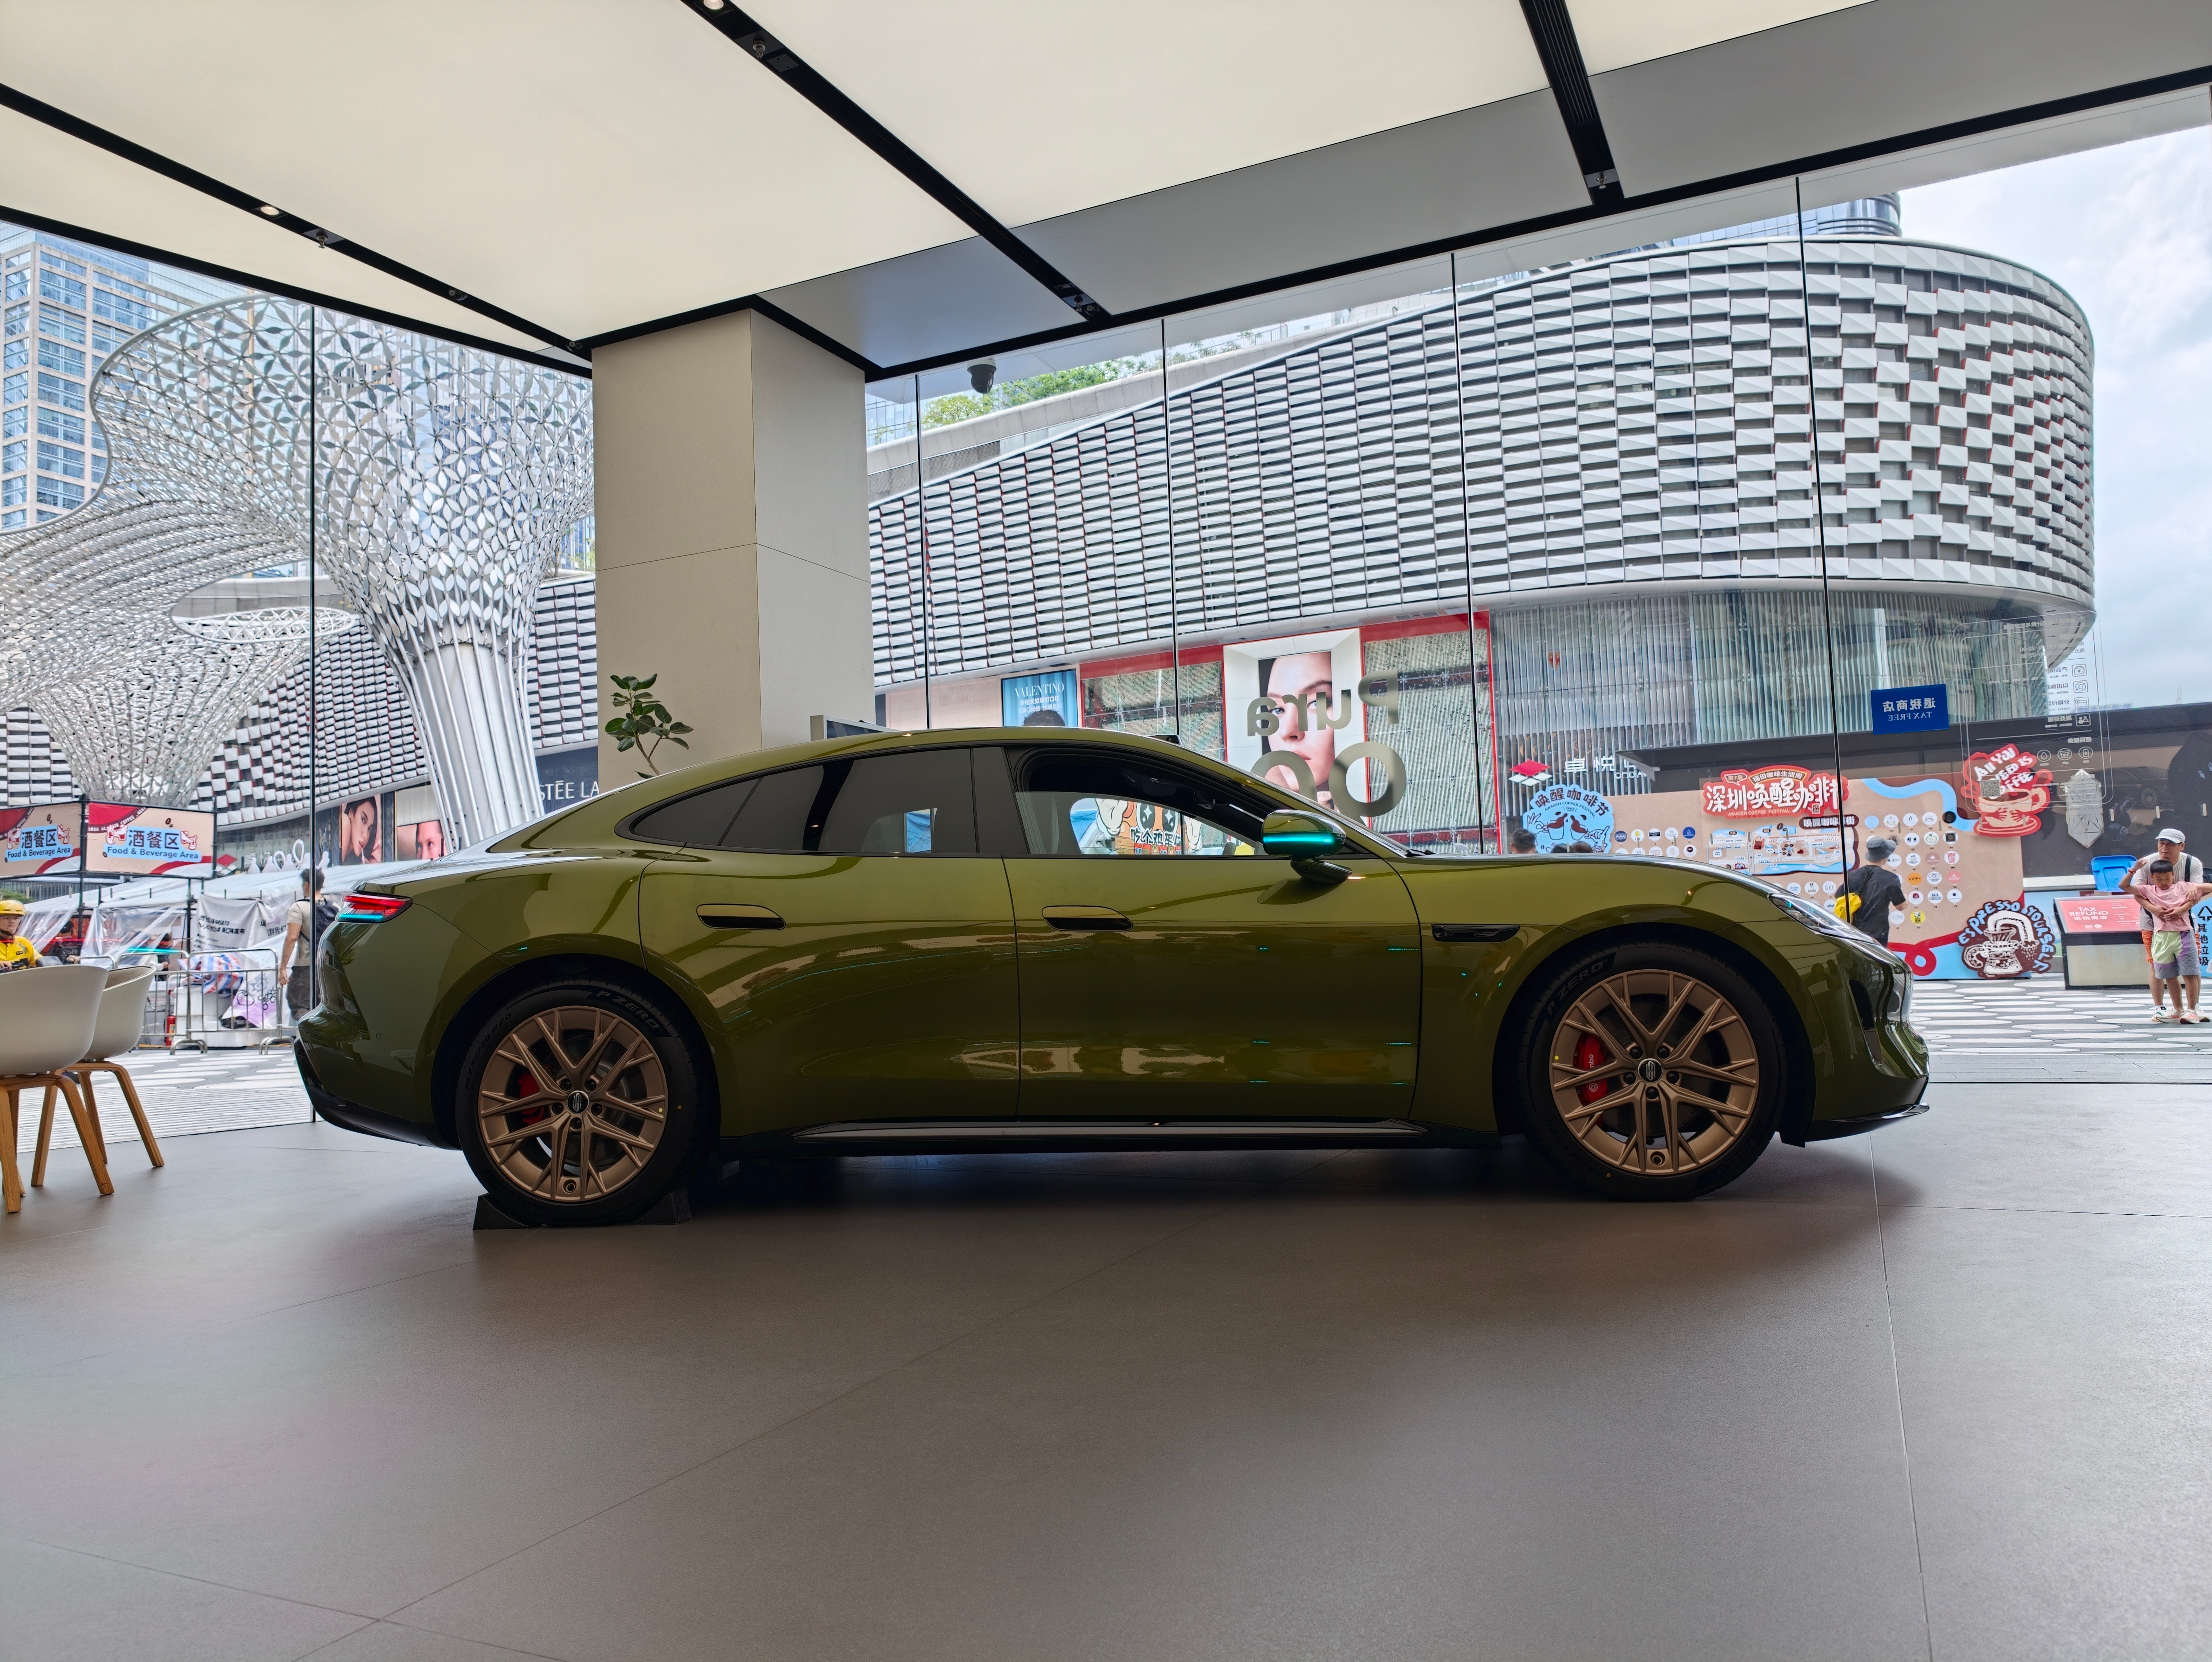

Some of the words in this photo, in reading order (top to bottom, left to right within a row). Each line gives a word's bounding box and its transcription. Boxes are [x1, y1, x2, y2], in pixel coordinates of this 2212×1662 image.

[1014, 682, 1064, 697] VALENTINO
[1535, 788, 1609, 816] 唤醒咖啡节
[1803, 816, 1855, 827] 唤醒咖啡街
[21, 828, 57, 849] 酒餐区
[129, 830, 179, 849] 酒餐区
[140, 849, 177, 859] Beverage
[1958, 901, 2021, 944] ESPRESSO
[2027, 906, 2054, 971] YOURSELF
[1547, 1001, 1555, 1016] P
[1557, 961, 1603, 1001] ZERO
[492, 1012, 511, 1033] R20
[612, 996, 660, 1029] ZERO
